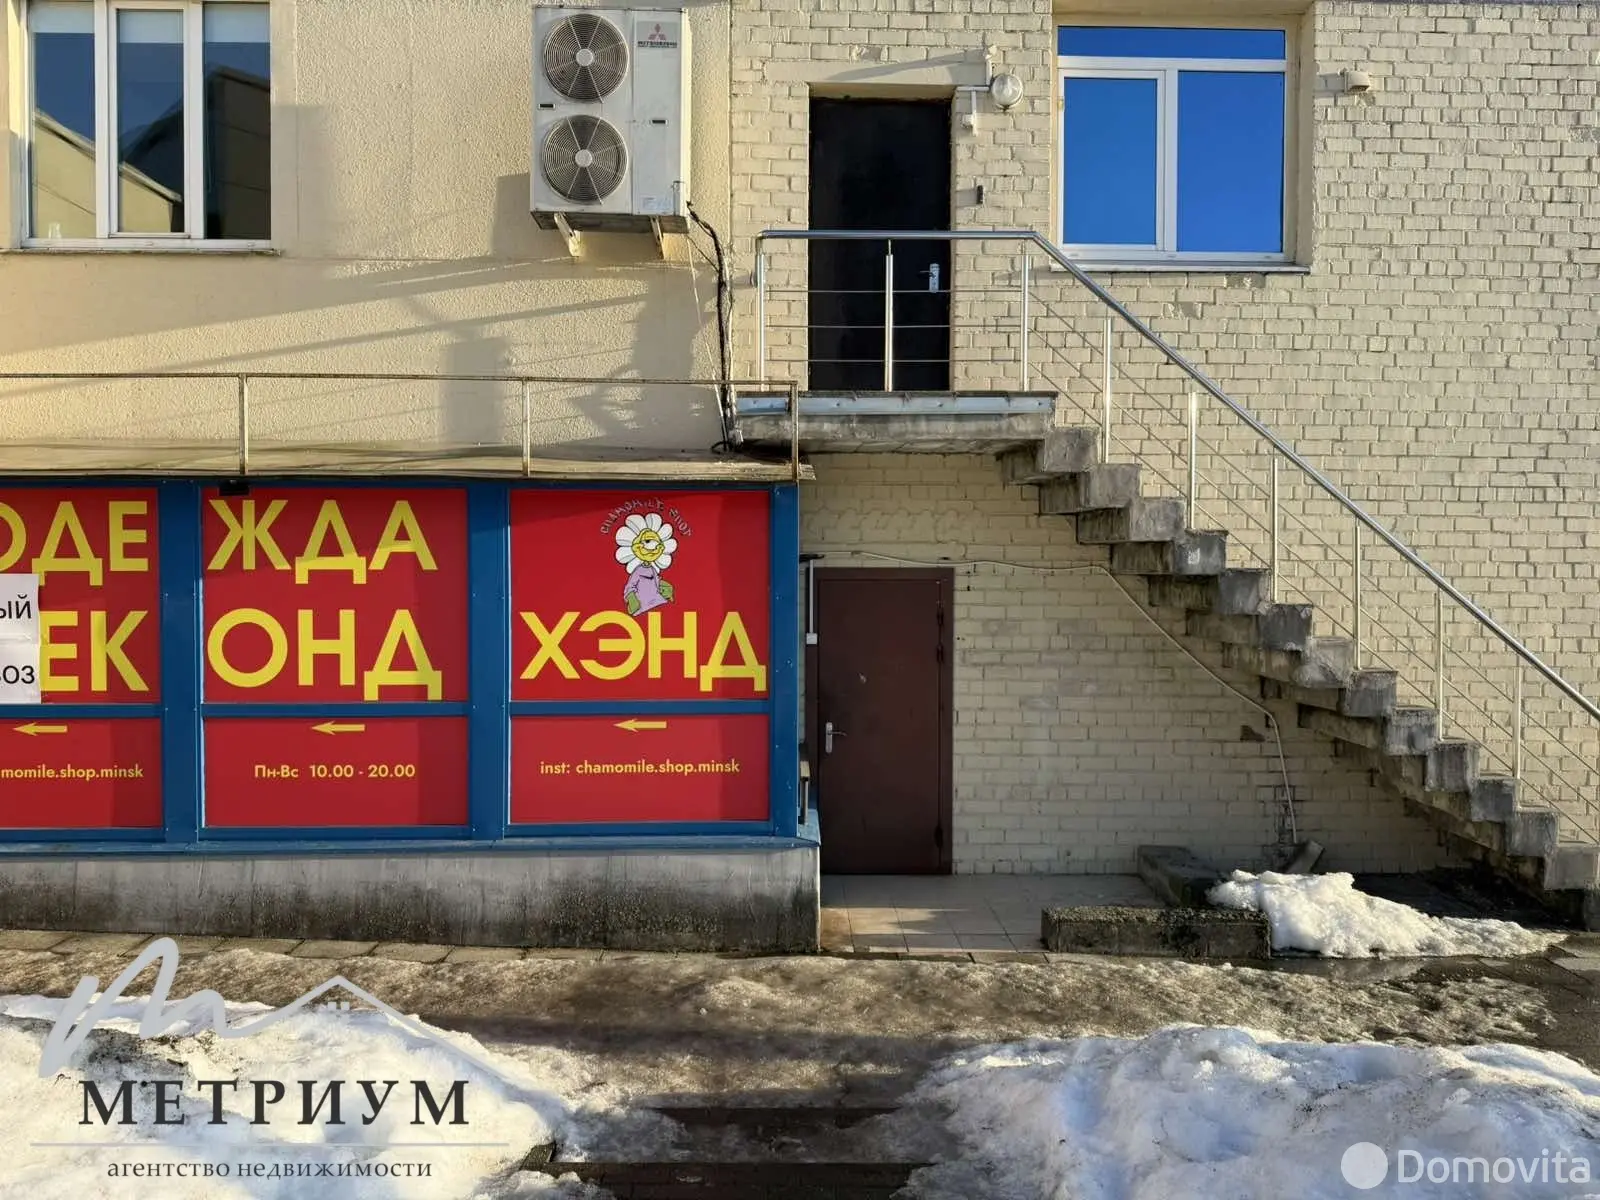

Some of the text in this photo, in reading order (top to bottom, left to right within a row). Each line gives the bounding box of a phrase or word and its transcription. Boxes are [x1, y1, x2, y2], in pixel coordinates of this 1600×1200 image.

[207, 500, 438, 584] ЖДА
[207, 607, 442, 701] ОНД
[519, 610, 767, 692] ХЭНД
[0, 763, 143, 781] momile.shop.minsk
[254, 764, 299, 778] Пн-Вс
[309, 764, 354, 778] 10.00
[367, 764, 416, 778] 20.00
[540, 758, 740, 776] inst: chamomile.shop.minsk
